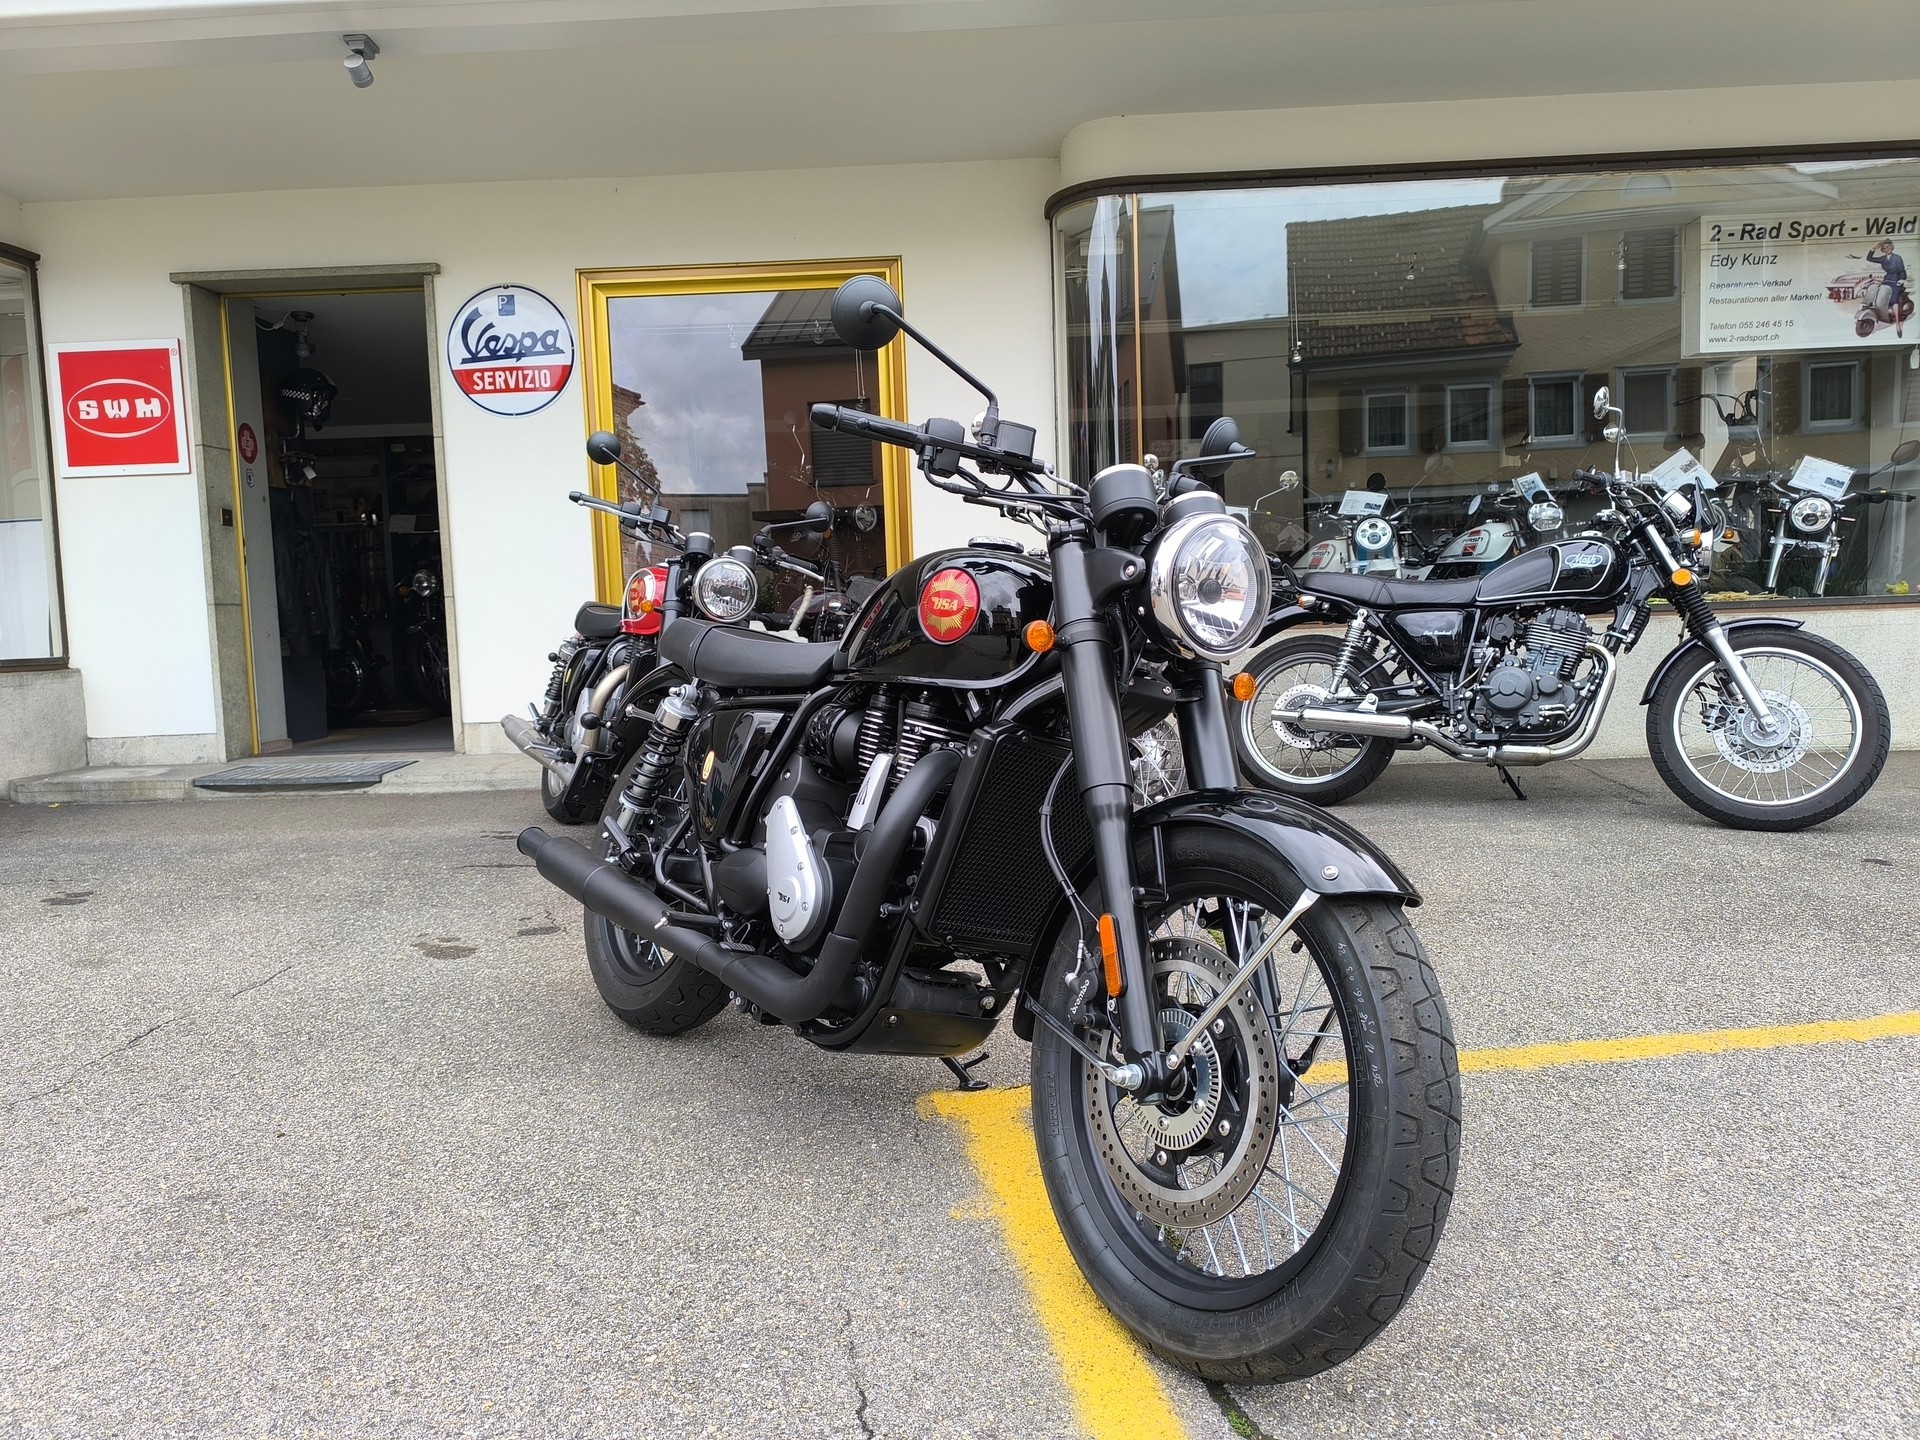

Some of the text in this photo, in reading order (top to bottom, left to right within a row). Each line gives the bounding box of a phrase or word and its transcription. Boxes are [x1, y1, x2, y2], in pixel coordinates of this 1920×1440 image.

[1710, 224, 1722, 242] 2
[1740, 221, 1782, 240] Rad
[1788, 219, 1846, 242] Sport
[1866, 215, 1918, 235] Wald
[1710, 252, 1778, 270] Edy Kunz
[1709, 278, 1793, 291] Reparaturen-Verkauf
[1708, 296, 1769, 305] Restaurationen
[1789, 293, 1822, 301] Marken!
[1709, 322, 1737, 331] Telefon
[1738, 321, 1754, 329] 055
[1755, 320, 1771, 329] 246
[1784, 319, 1795, 327] 15
[460, 306, 565, 364] Vespa
[1708, 333, 1780, 343] www.2-radsport.ch
[472, 369, 551, 391] SERVIZIO
[77, 397, 162, 420] SWM
[931, 596, 959, 611] BSA
[1070, 979, 1090, 1015] brembo
